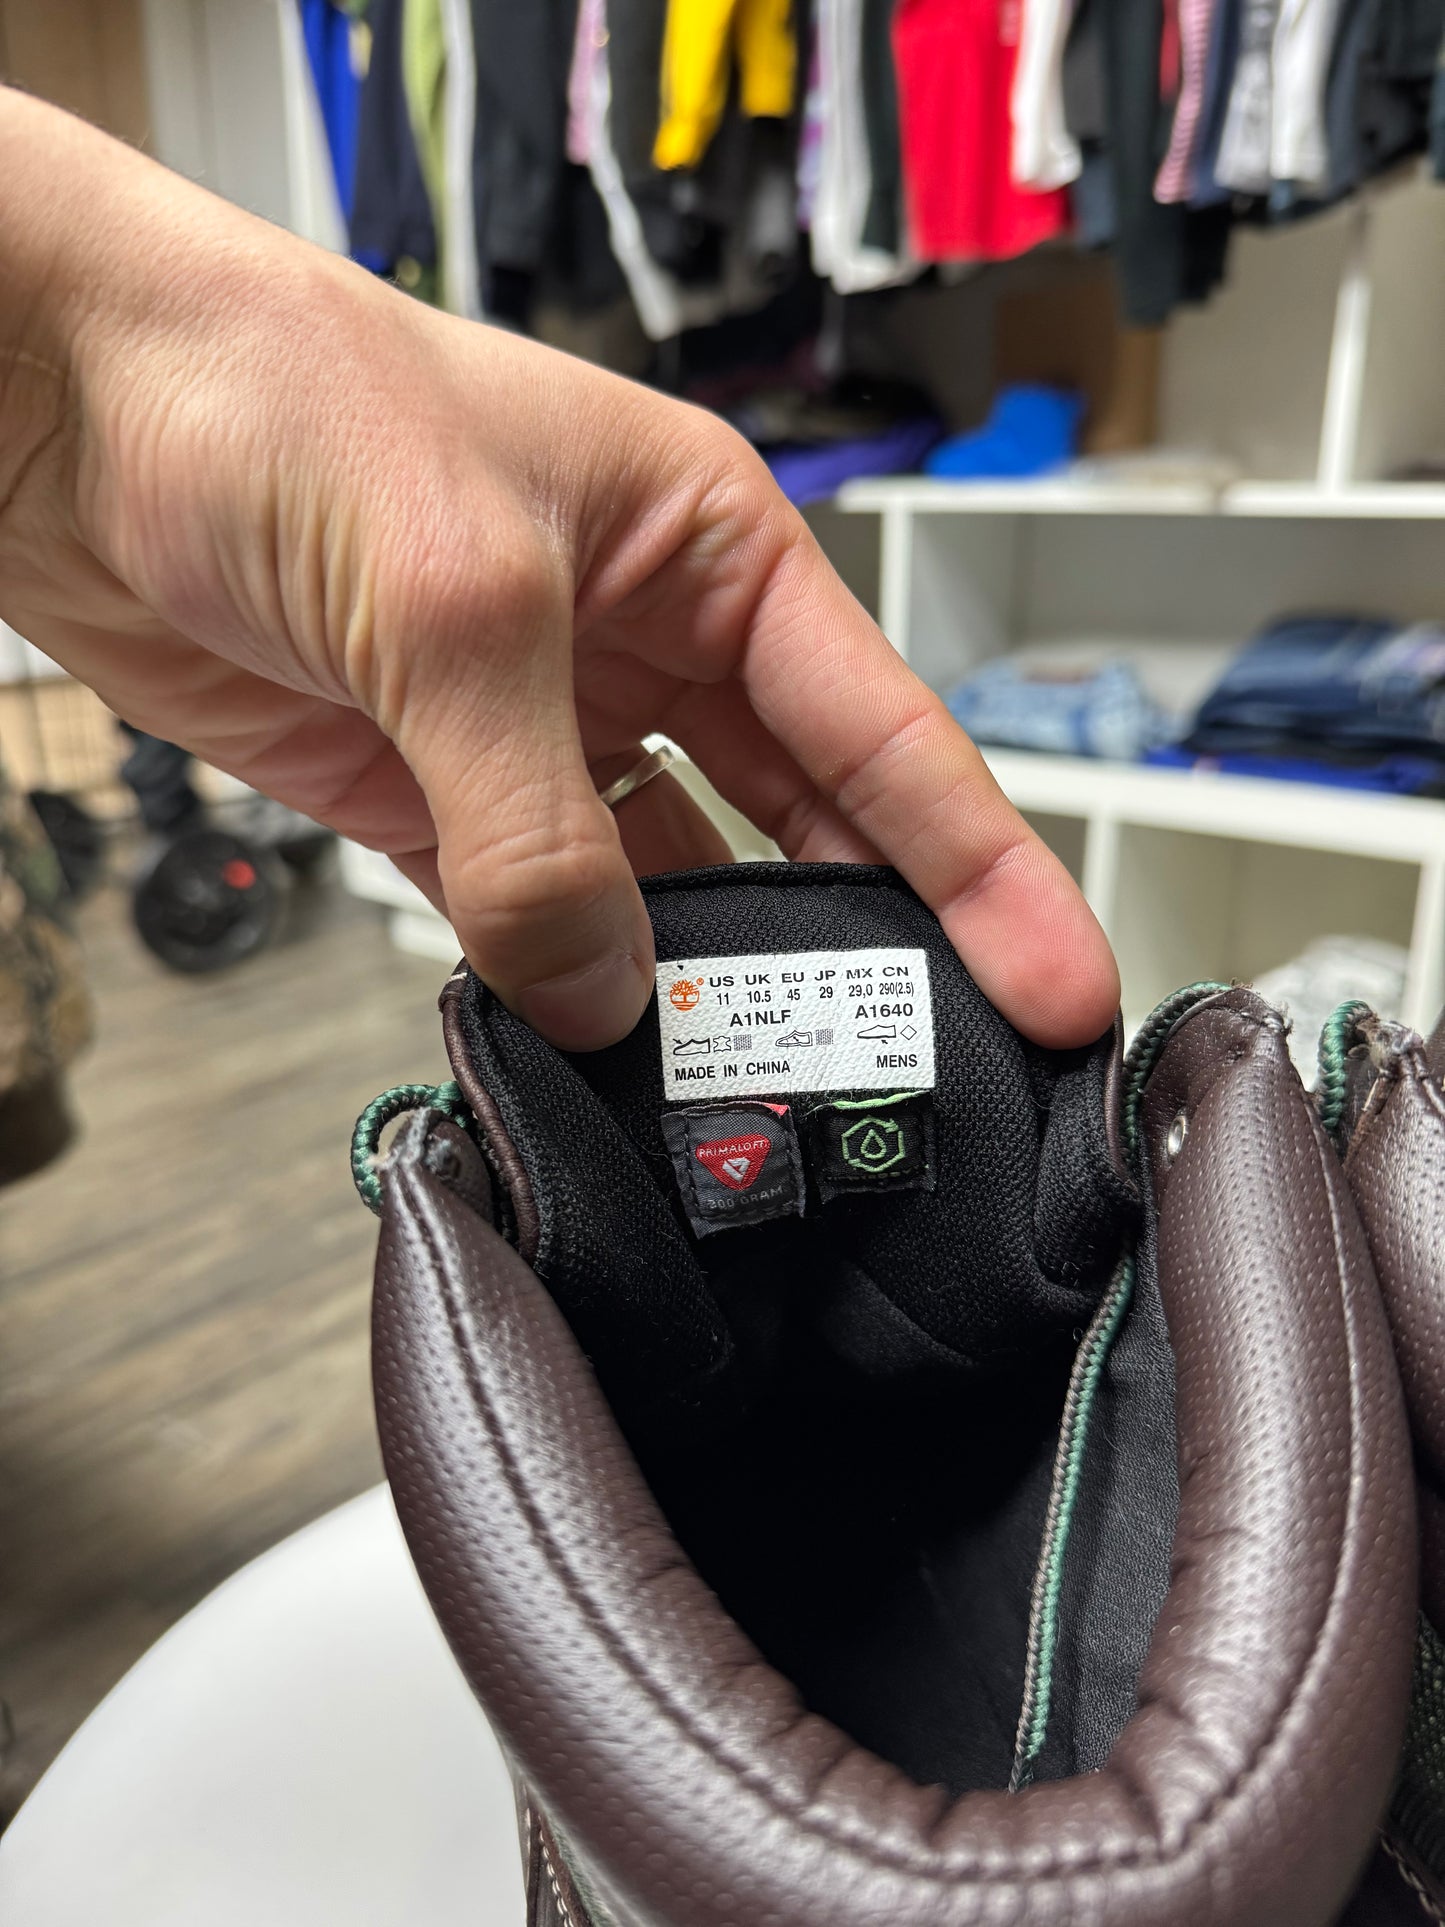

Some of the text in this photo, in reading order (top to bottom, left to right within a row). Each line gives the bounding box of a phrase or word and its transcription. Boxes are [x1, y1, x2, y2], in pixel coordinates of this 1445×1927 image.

[709, 966, 909, 988] US UK EU JP MX CN
[716, 992, 730, 1005] 11
[747, 990, 772, 1003] 10.5
[787, 988, 801, 1001] 45
[819, 986, 833, 999] 29
[879, 981, 914, 998] 290(2.5)
[729, 1009, 791, 1027] A1NLF
[855, 1003, 914, 1019] A1640
[675, 1060, 791, 1081] MADE IN CHINA
[876, 1054, 918, 1068] MENS
[699, 1139, 765, 1157] PRIMALOFT
[740, 1185, 783, 1205] GRAM
